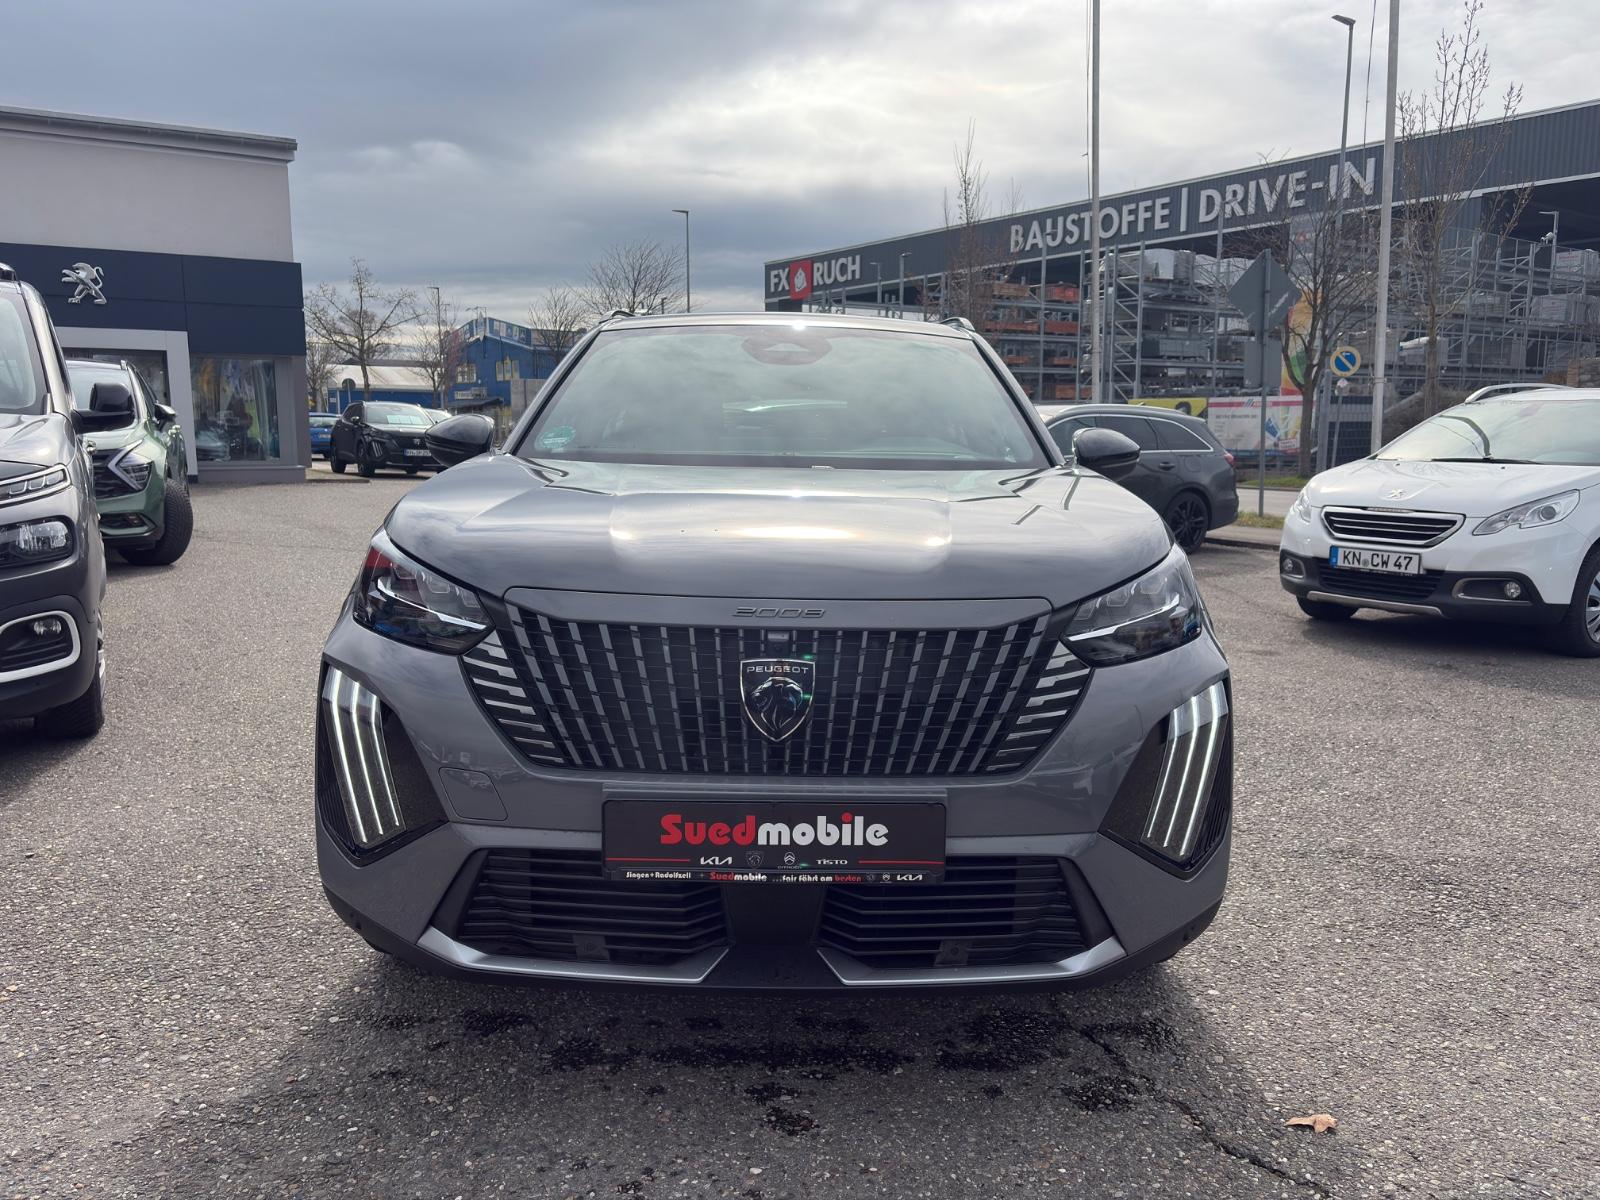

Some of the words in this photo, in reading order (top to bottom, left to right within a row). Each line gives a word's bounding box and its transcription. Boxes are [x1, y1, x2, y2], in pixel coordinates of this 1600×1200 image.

[1010, 196, 1171, 253] BAUSTOFFE
[1198, 157, 1376, 224] DRIVE-IN
[770, 267, 790, 293] FX
[813, 254, 861, 286] RUCH
[1343, 550, 1362, 566] KN
[1370, 553, 1391, 569] CW
[1393, 555, 1413, 571] 47
[732, 606, 826, 619] 2008
[746, 665, 809, 675] PEUGEOT
[660, 812, 889, 847] Suedmobile
[700, 856, 733, 865] KIA
[709, 872, 768, 882] Suedmobile
